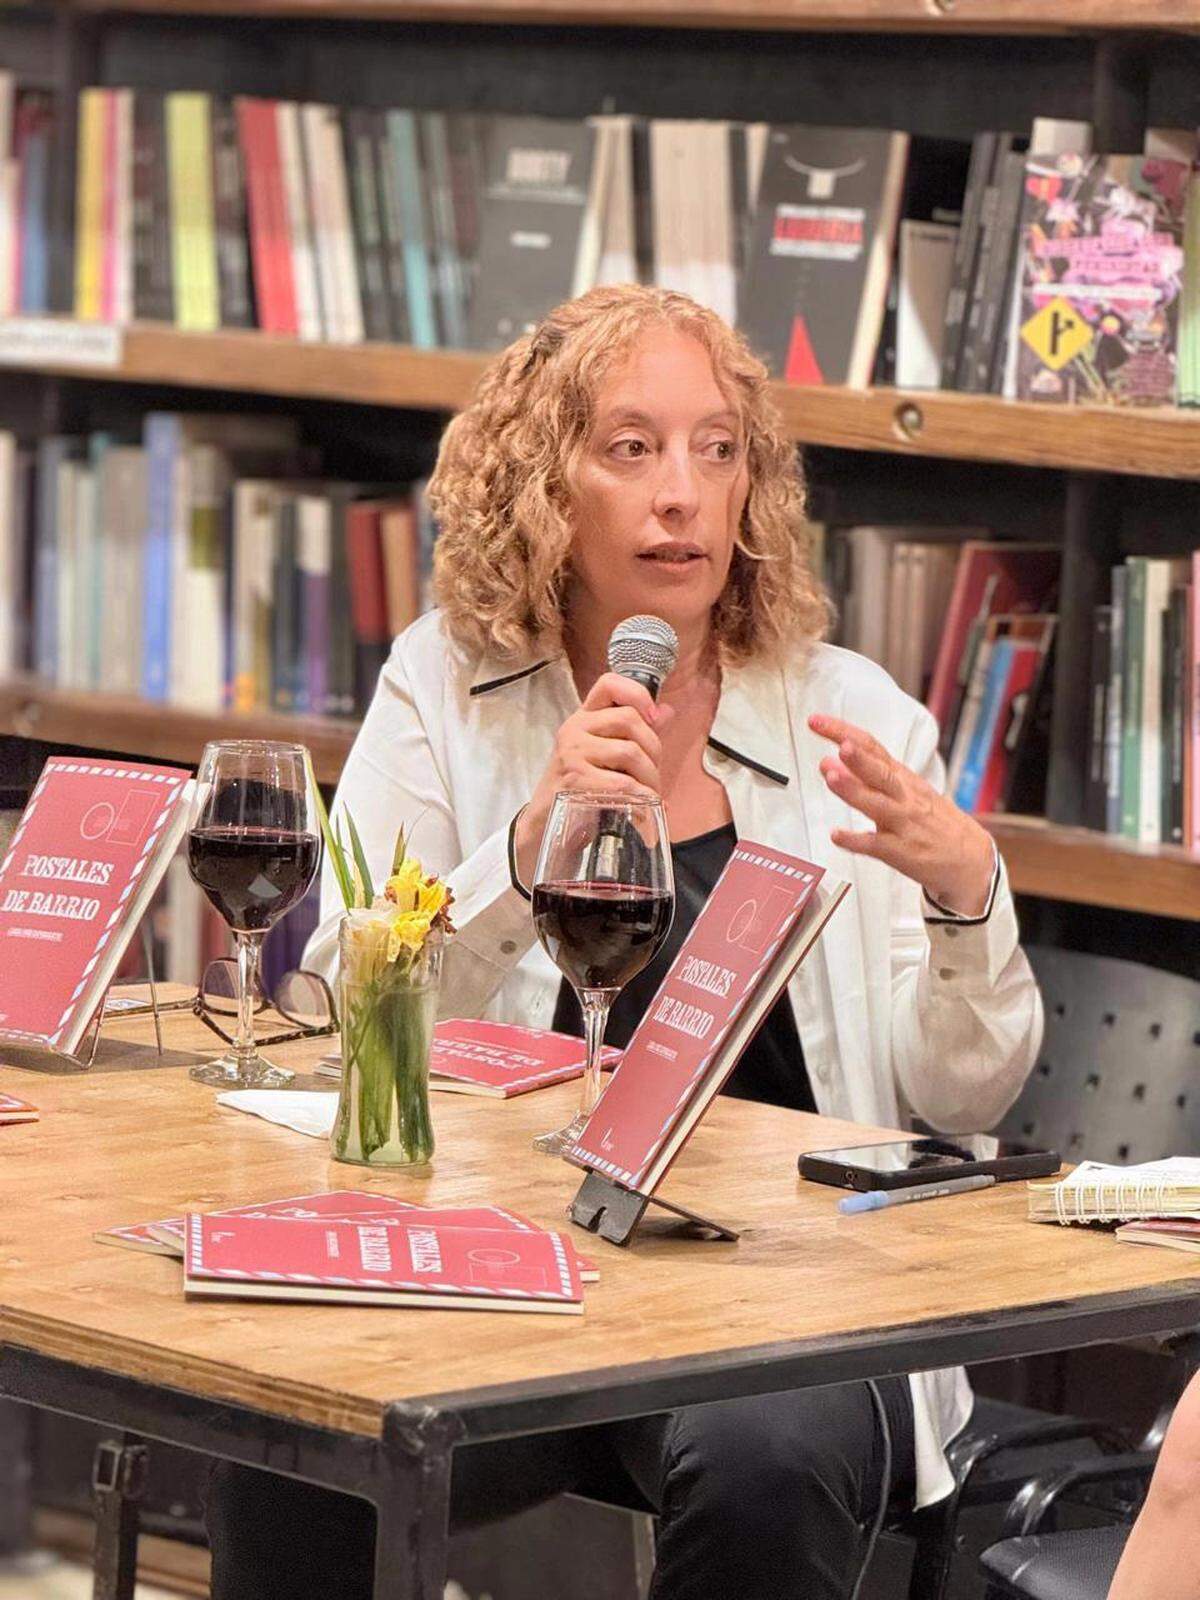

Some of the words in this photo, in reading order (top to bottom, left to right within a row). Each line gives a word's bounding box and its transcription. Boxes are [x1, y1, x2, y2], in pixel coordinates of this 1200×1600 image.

[22, 854, 114, 885] POSTALES
[0, 889, 30, 912] DE
[26, 891, 100, 921] BARRIO
[676, 955, 737, 999] POSTALES
[653, 996, 676, 1023] DE
[666, 1000, 714, 1039] BARRIO
[359, 1236, 392, 1272] BARRIO
[406, 1228, 442, 1273] POSTALES
